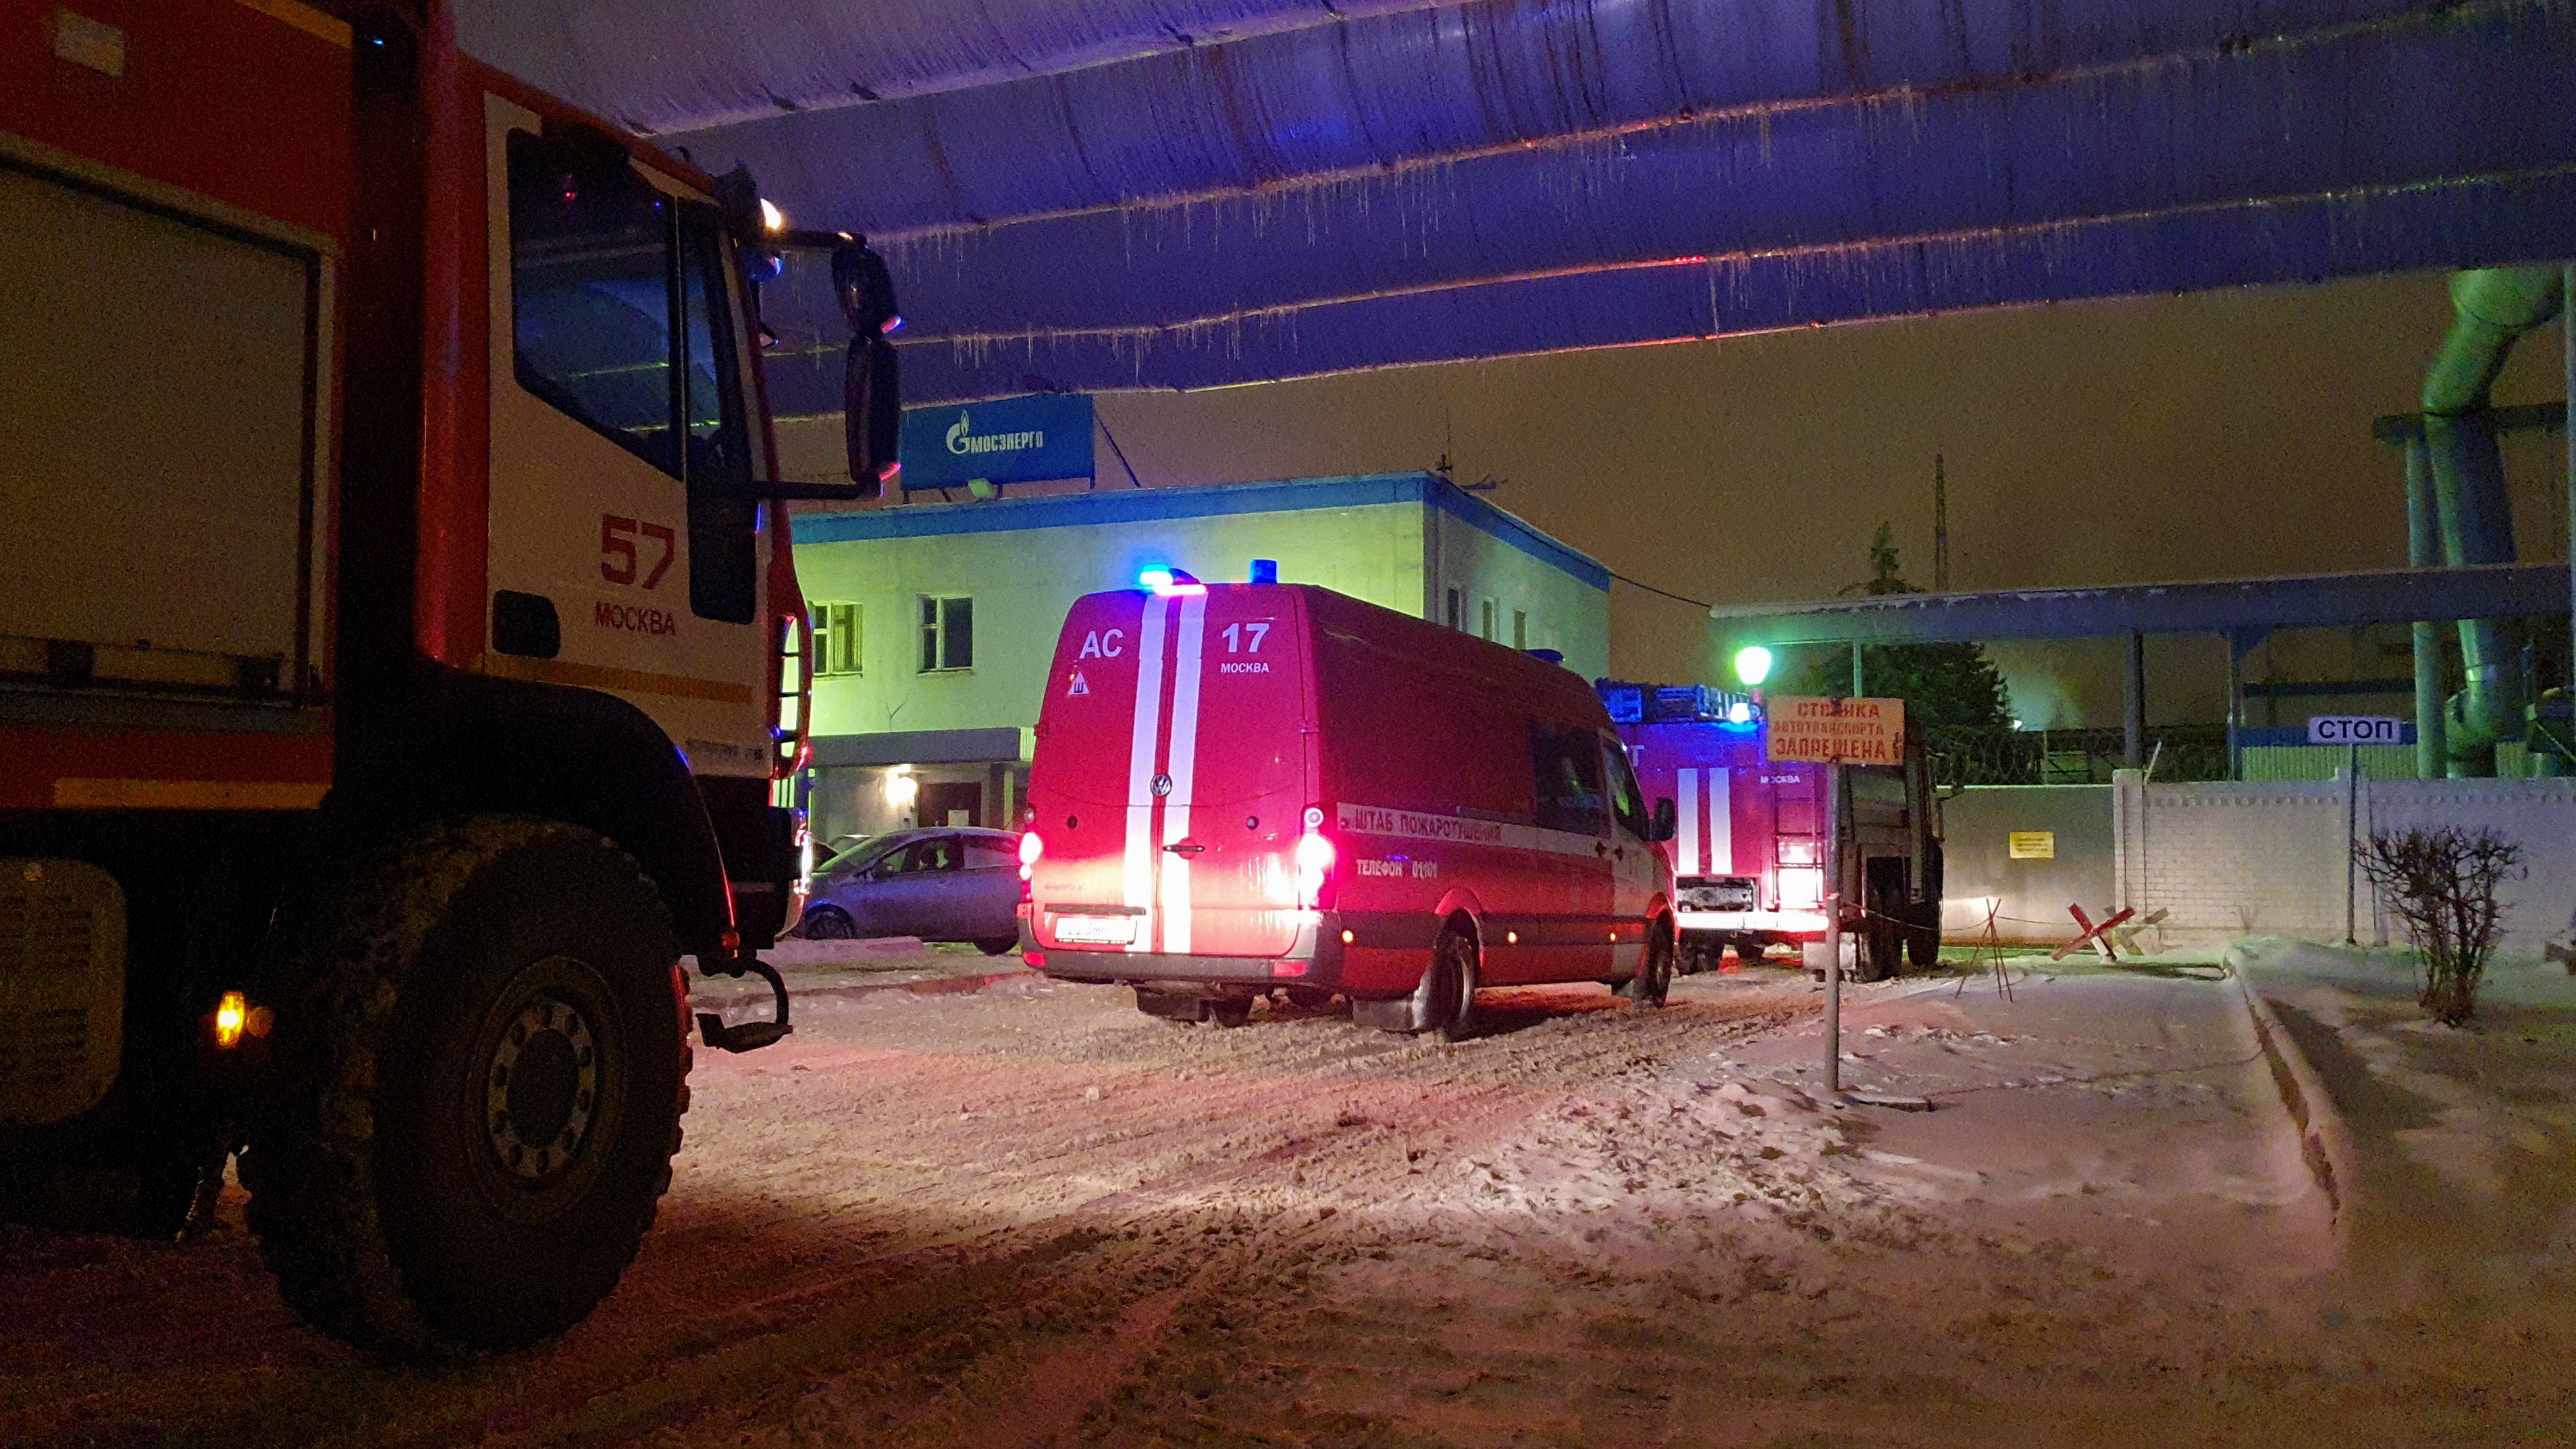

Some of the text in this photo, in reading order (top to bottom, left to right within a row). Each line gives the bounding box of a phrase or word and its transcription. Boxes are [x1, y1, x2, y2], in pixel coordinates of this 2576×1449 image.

[602, 514, 675, 589] 57
[596, 601, 675, 635] МОСКВА
[1079, 629, 1124, 660] АС
[1221, 623, 1269, 653] 17
[1220, 662, 1270, 674] МОСКВА
[1797, 702, 1881, 718] СТОНКА
[1774, 720, 1885, 735] АВТОТРАНСПОРТА
[2319, 720, 2392, 739] СТОП
[1775, 737, 1886, 760] ЗАПРЕЩЕНА
[1355, 808, 1393, 832] ШТАБ
[1357, 859, 1403, 878] ТЕЛЕФОН
